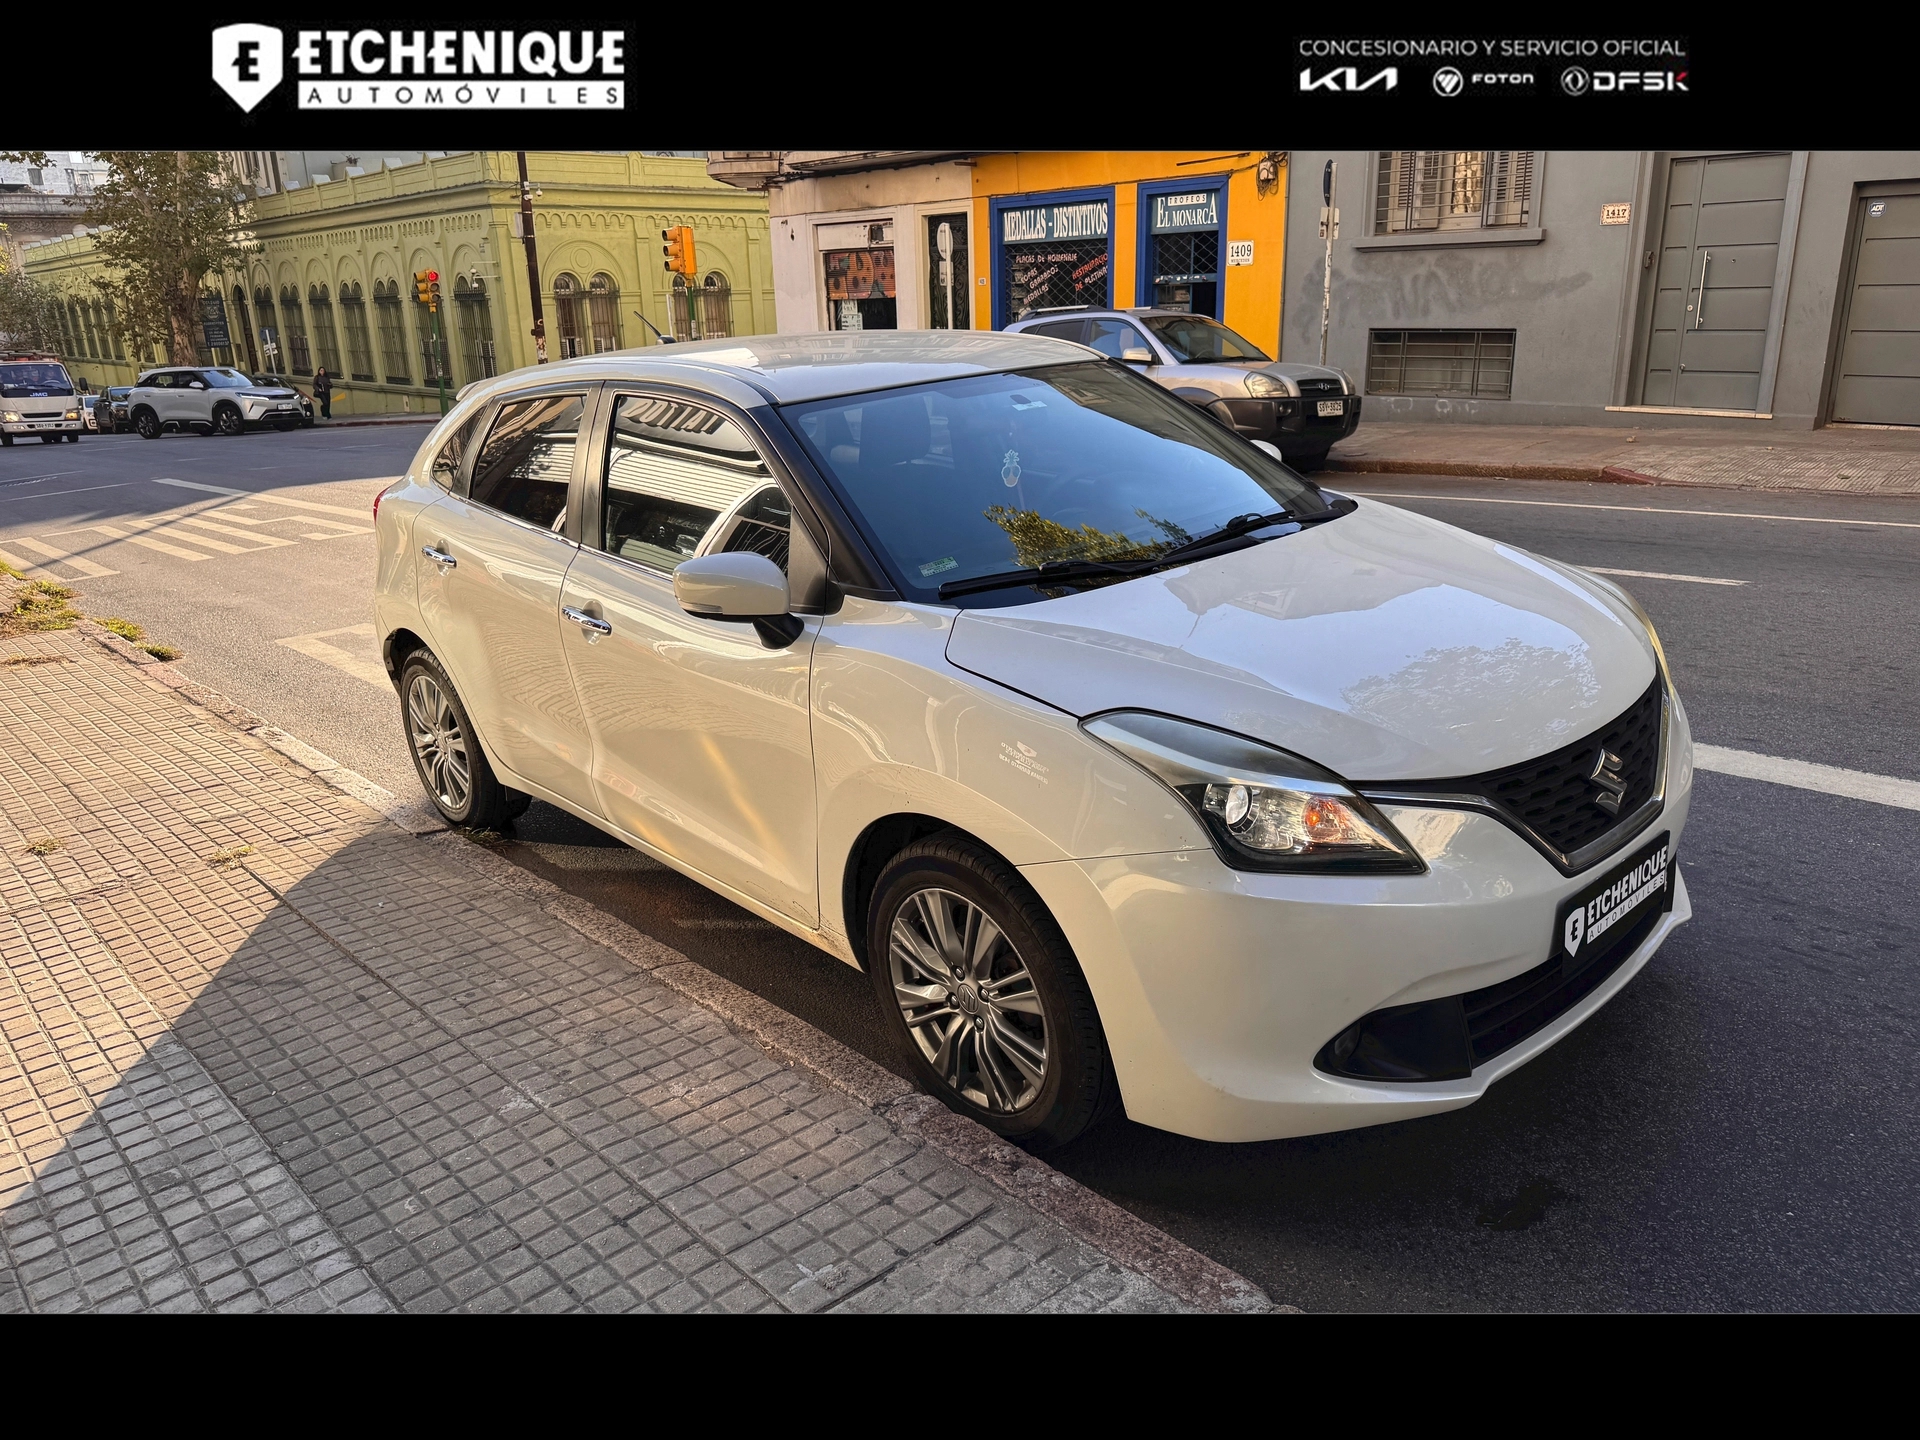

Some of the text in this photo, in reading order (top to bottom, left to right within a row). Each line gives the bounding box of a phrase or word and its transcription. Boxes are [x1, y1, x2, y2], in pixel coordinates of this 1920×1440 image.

[1169, 194, 1206, 204] TROFEOS
[1172, 193, 1218, 227] MONARCA
[1003, 208, 1047, 242] MEDALLAS
[1053, 202, 1109, 238] DISTINTIVOS
[1016, 254, 1035, 263] PLACAS
[1230, 244, 1252, 257] 1409
[1072, 253, 1108, 280] RESTAURACIO
[1587, 845, 1667, 926] ETCHENIQUE
